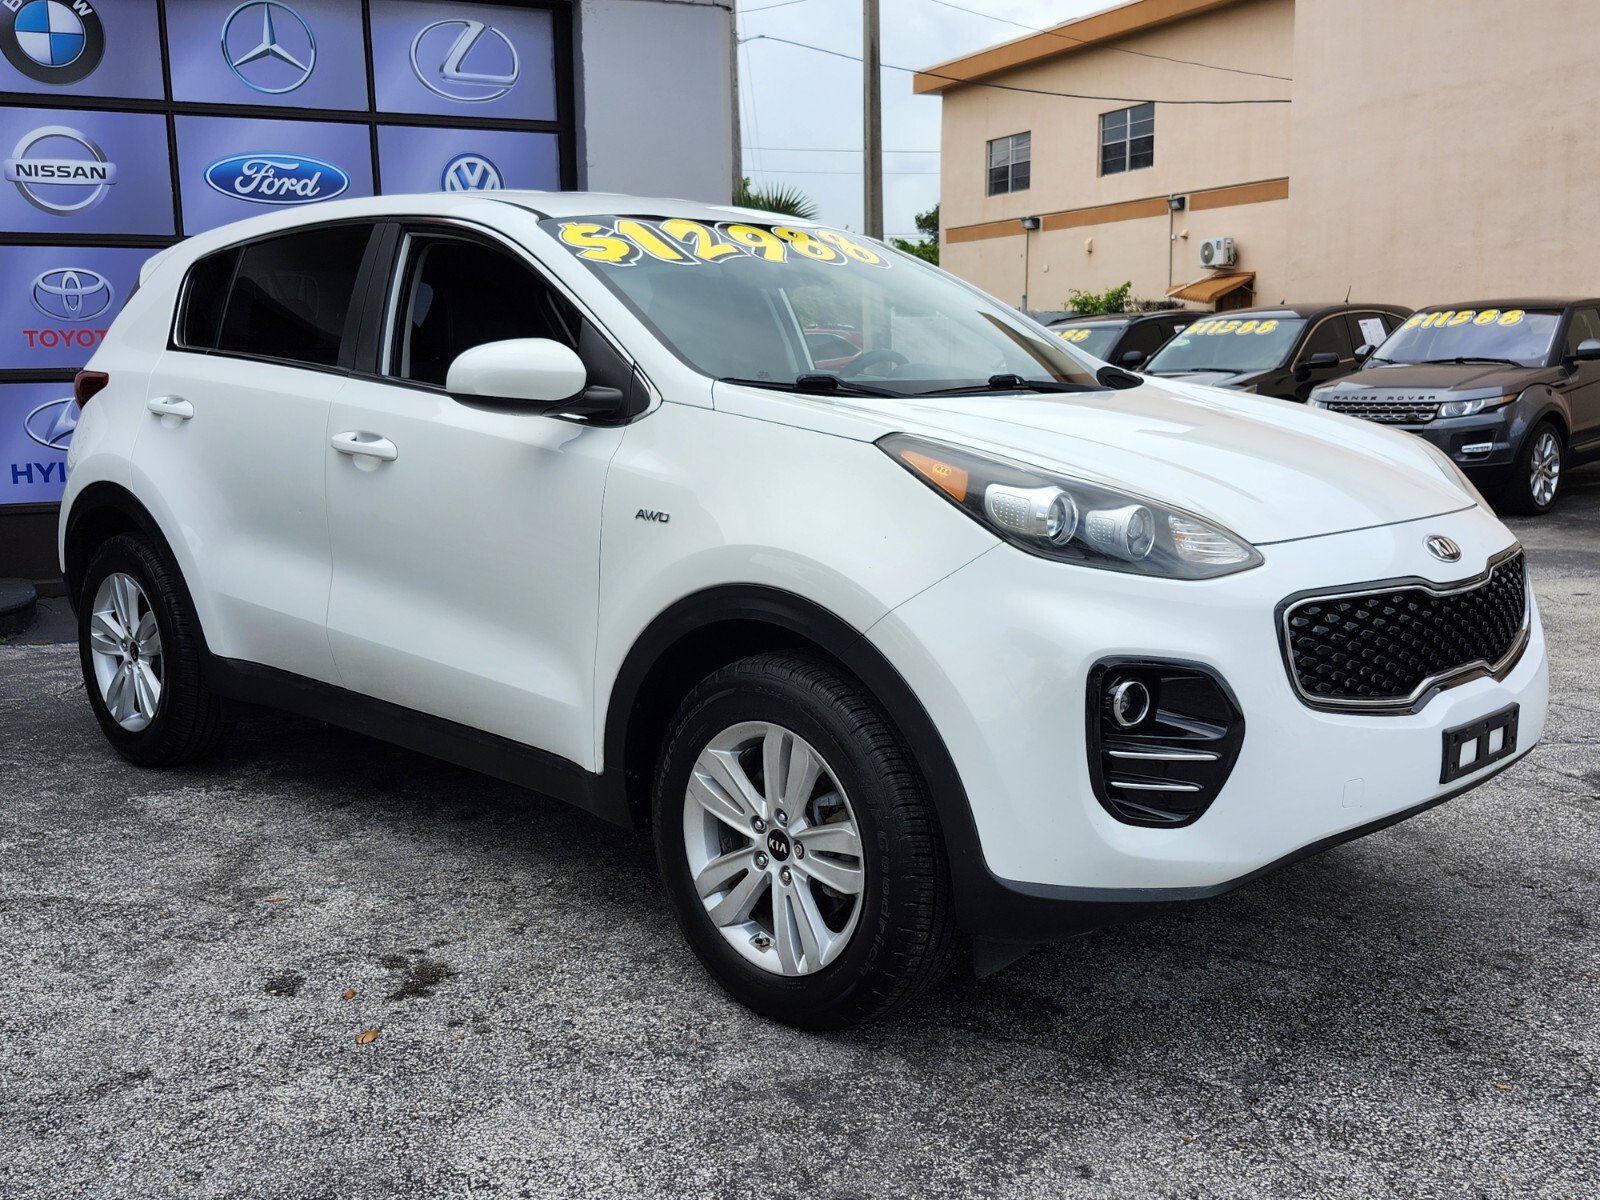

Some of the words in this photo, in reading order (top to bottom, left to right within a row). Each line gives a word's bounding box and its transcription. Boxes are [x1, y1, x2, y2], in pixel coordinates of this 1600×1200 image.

[2, 0, 93, 17] BW
[15, 163, 107, 180] NISSAN
[233, 158, 322, 198] Ford
[557, 218, 892, 268] $12988
[1403, 308, 1525, 332] $11588
[22, 328, 108, 348] TOYOT
[635, 508, 670, 523] AWD
[768, 837, 787, 854] KIA
